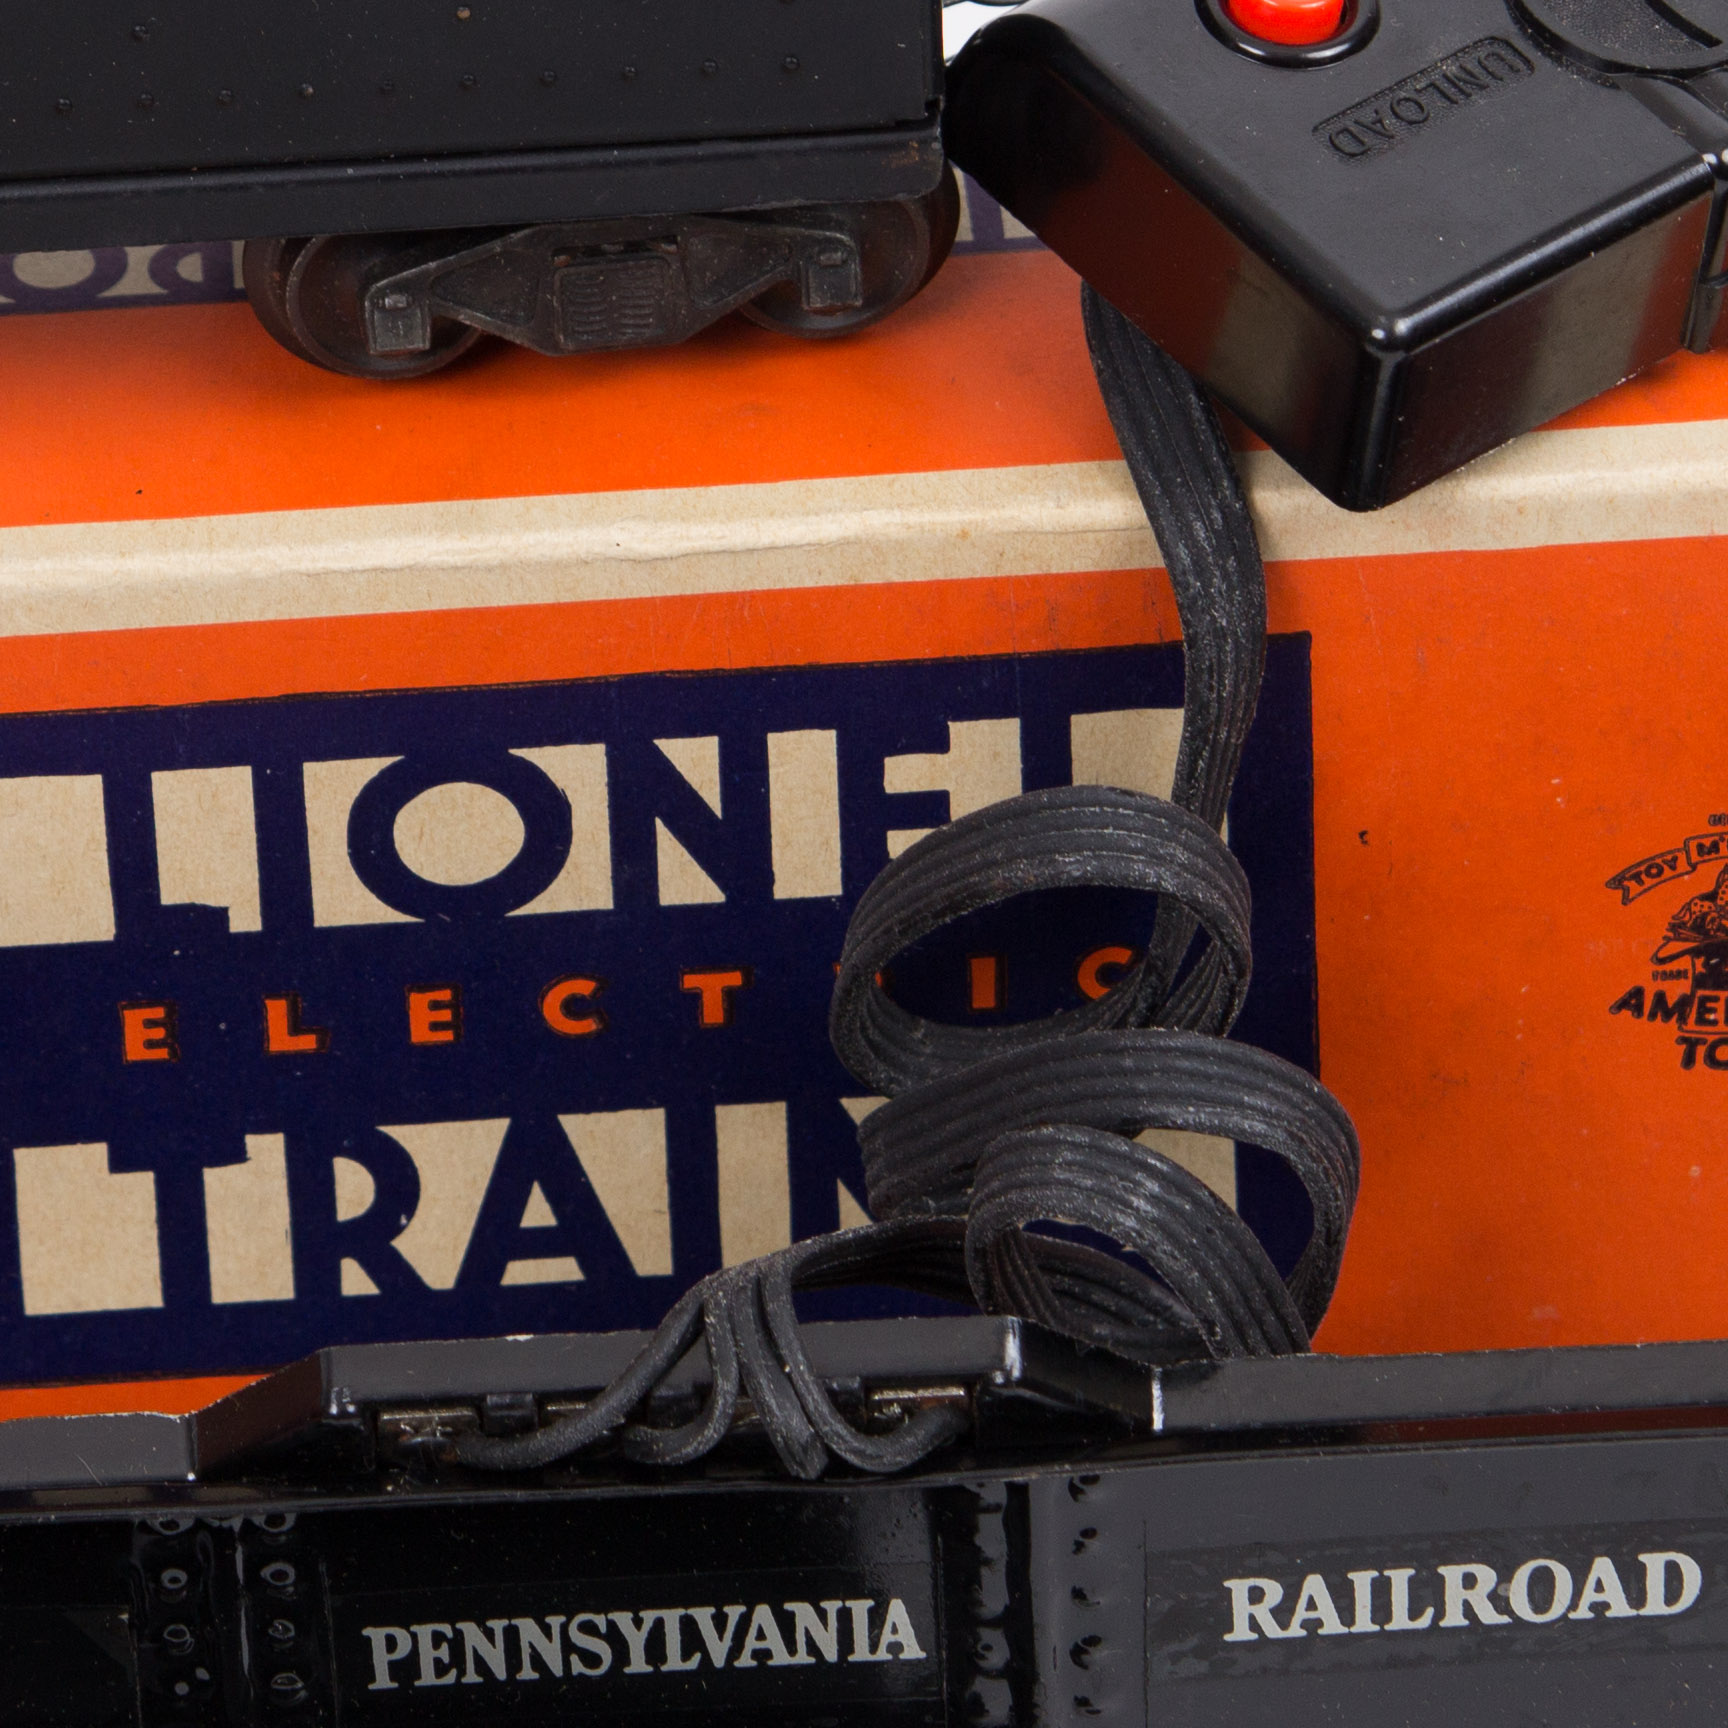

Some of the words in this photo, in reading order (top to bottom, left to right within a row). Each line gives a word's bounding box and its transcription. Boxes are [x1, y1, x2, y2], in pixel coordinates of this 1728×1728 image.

[1328, 51, 1523, 158] UNLOAD
[1627, 856, 1679, 887] TOY
[120, 944, 1142, 1064] ELECTIC
[1223, 1551, 1704, 1643] RAILROAD
[362, 1598, 928, 1690] PENNSYLVANIA
